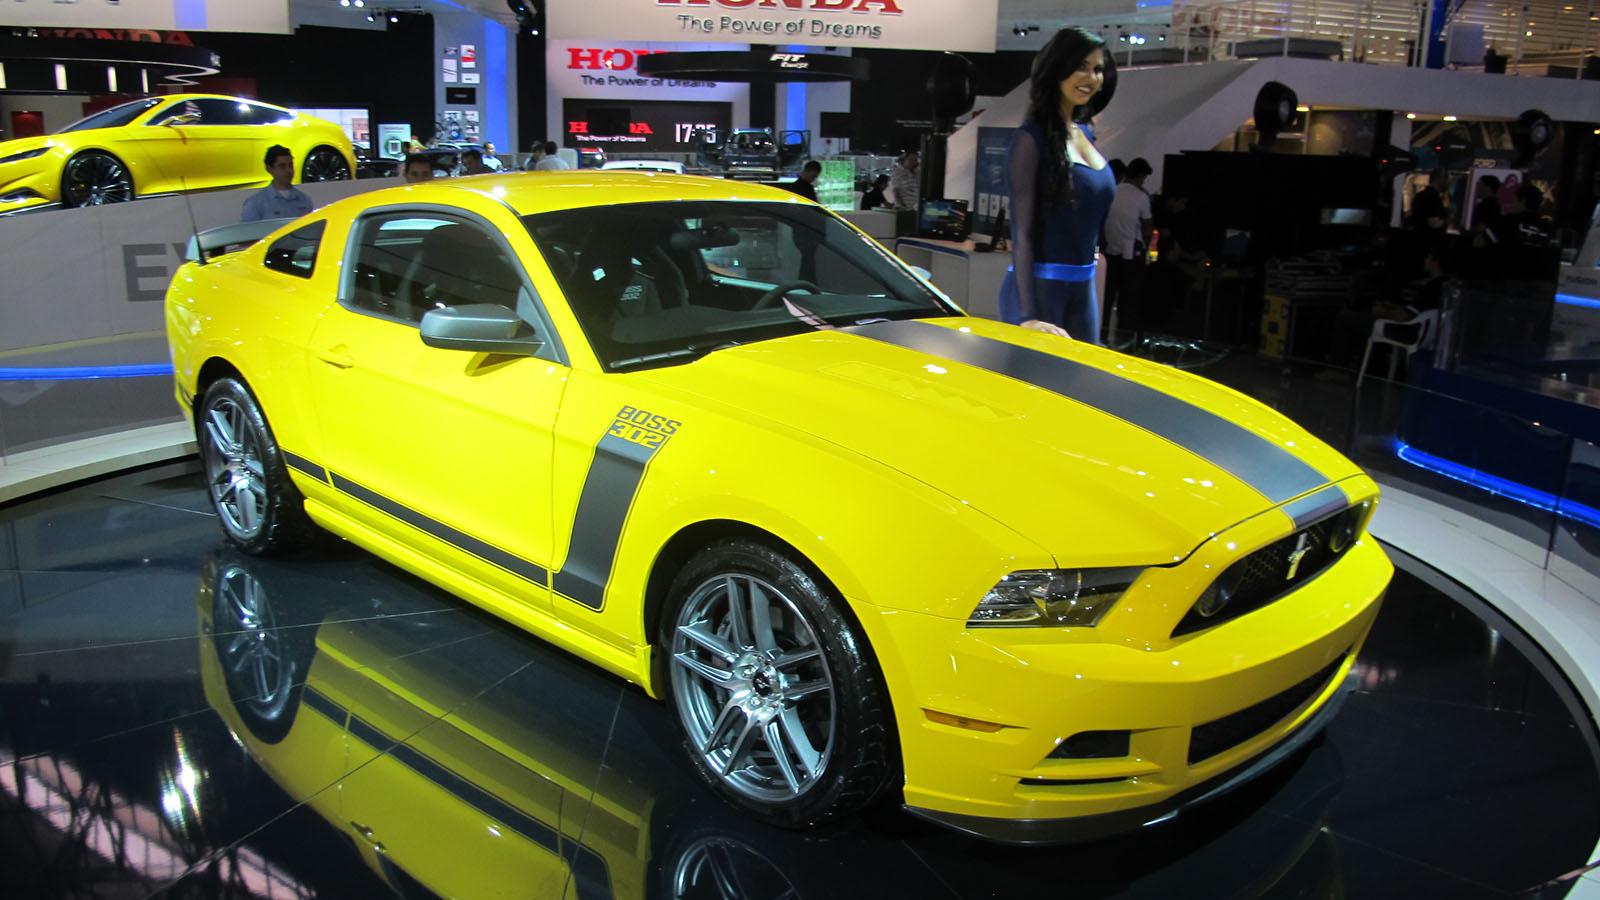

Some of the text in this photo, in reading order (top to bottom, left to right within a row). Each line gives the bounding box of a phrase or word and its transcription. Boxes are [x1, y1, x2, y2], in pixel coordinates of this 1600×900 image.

[678, 15, 882, 39] The Power of Dreams
[581, 74, 717, 89] The Power of Dreams
[675, 124, 716, 143] 17:5
[616, 405, 682, 435] BOSS
[608, 420, 664, 449] 302
